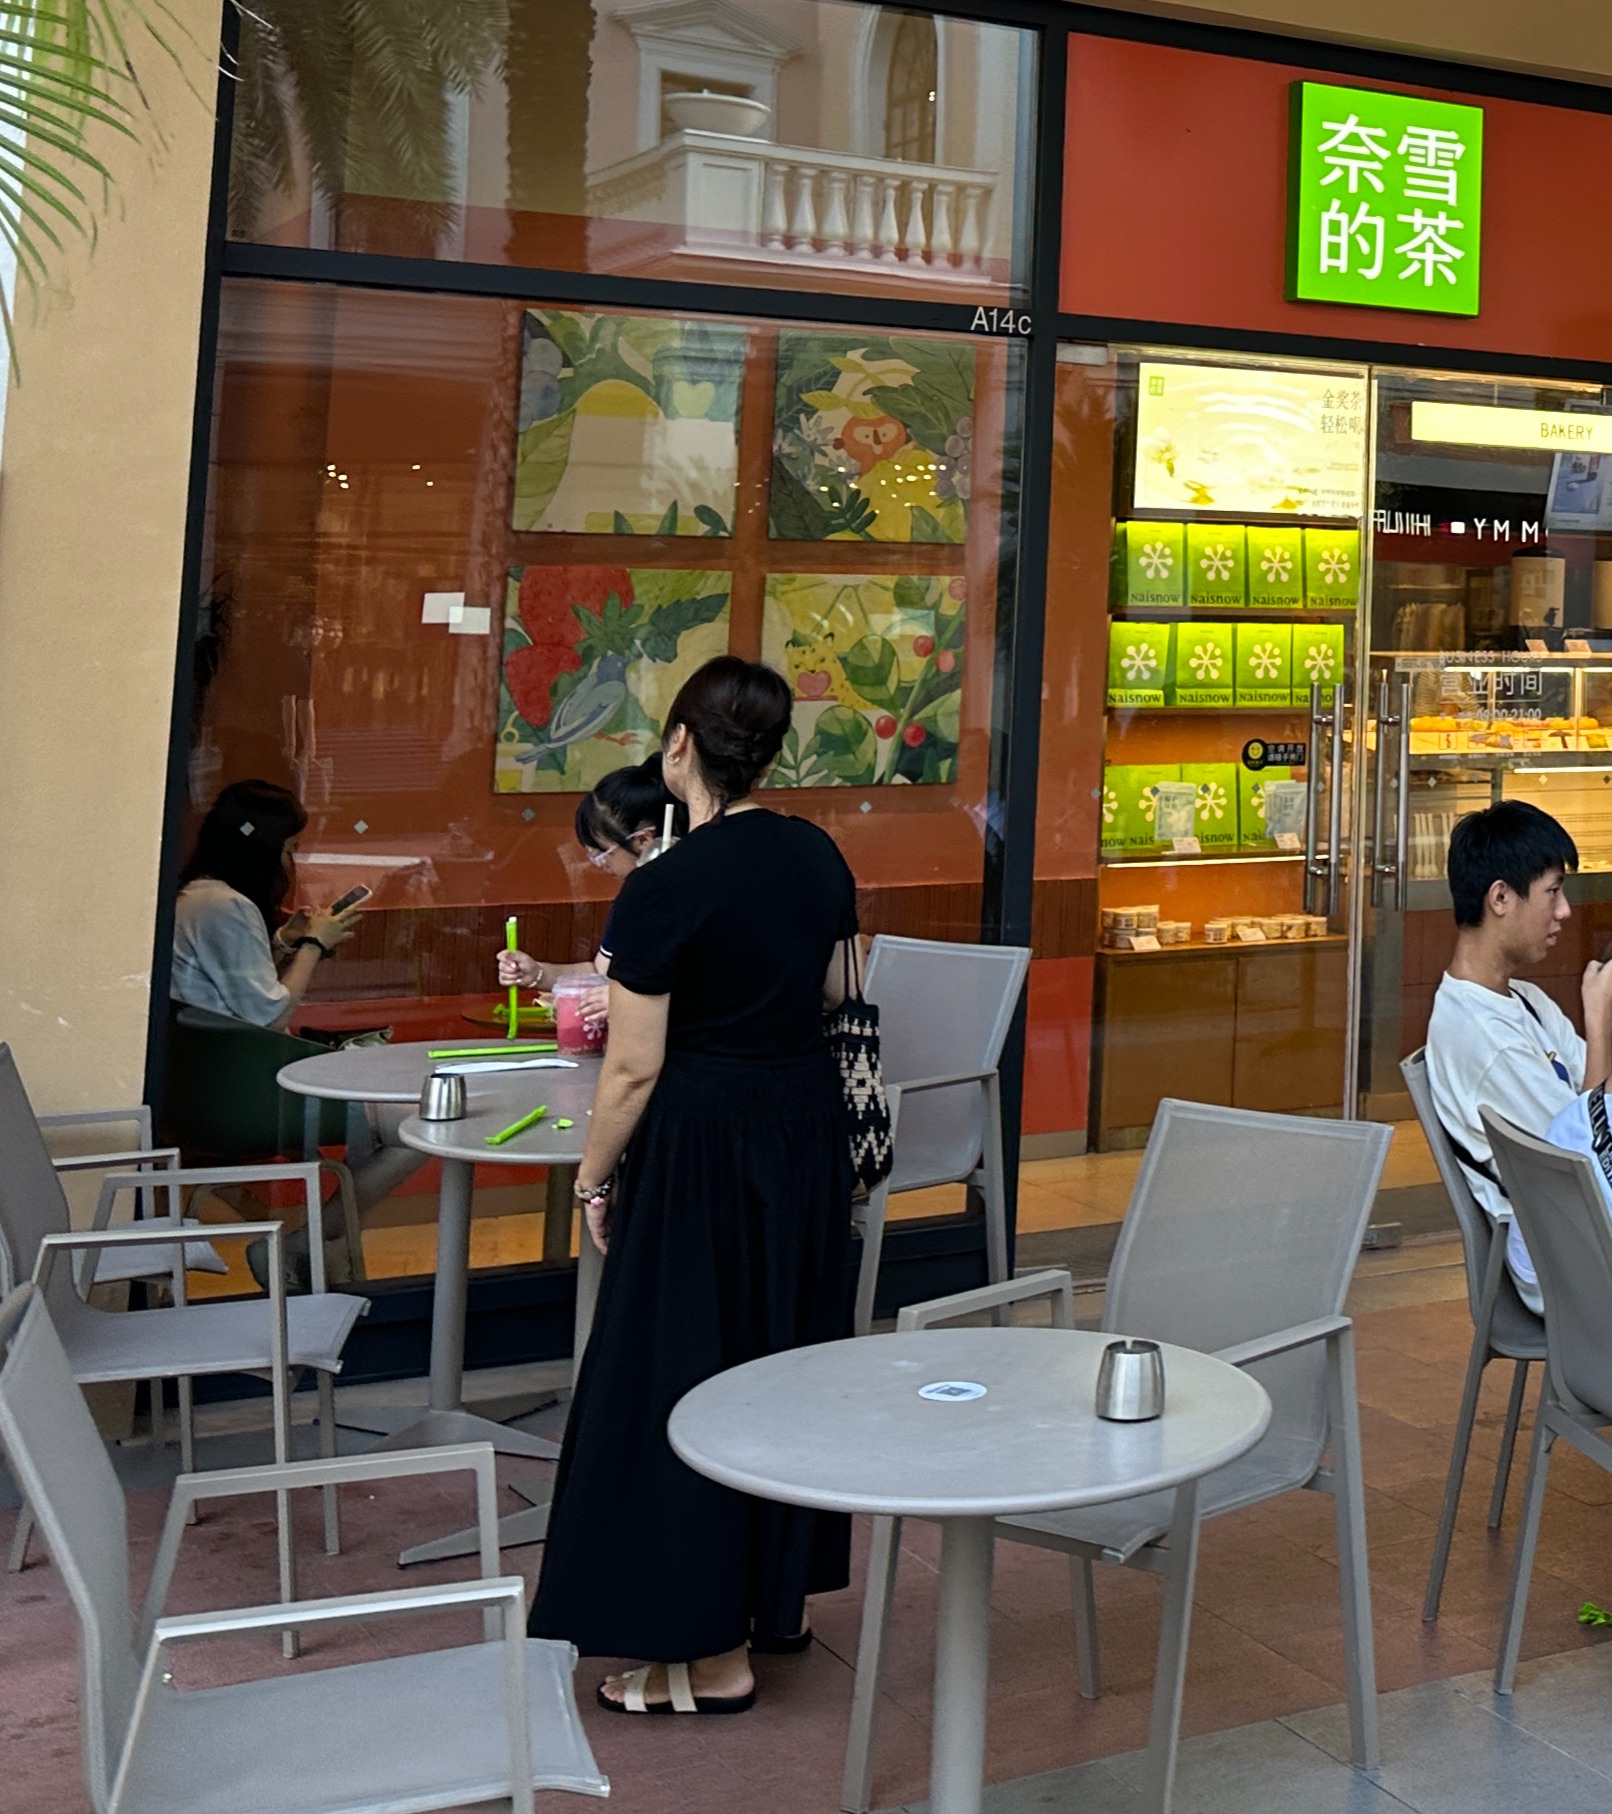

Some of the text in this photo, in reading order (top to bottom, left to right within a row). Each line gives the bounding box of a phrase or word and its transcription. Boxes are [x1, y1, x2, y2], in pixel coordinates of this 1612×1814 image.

[1317, 113, 1467, 207] 奈雪
[1319, 198, 1466, 287] 的茶
[970, 306, 1031, 334] A14c
[1541, 422, 1593, 440] BAKERY
[1190, 592, 1242, 605] Naisnow
[1252, 594, 1300, 606] Naisnow
[1440, 671, 1543, 696] 营业时间
[1108, 692, 1162, 704] Naisnow
[1179, 692, 1231, 704] Naisnow
[1239, 691, 1290, 703] Naisnow
[1129, 833, 1155, 846] Nais
